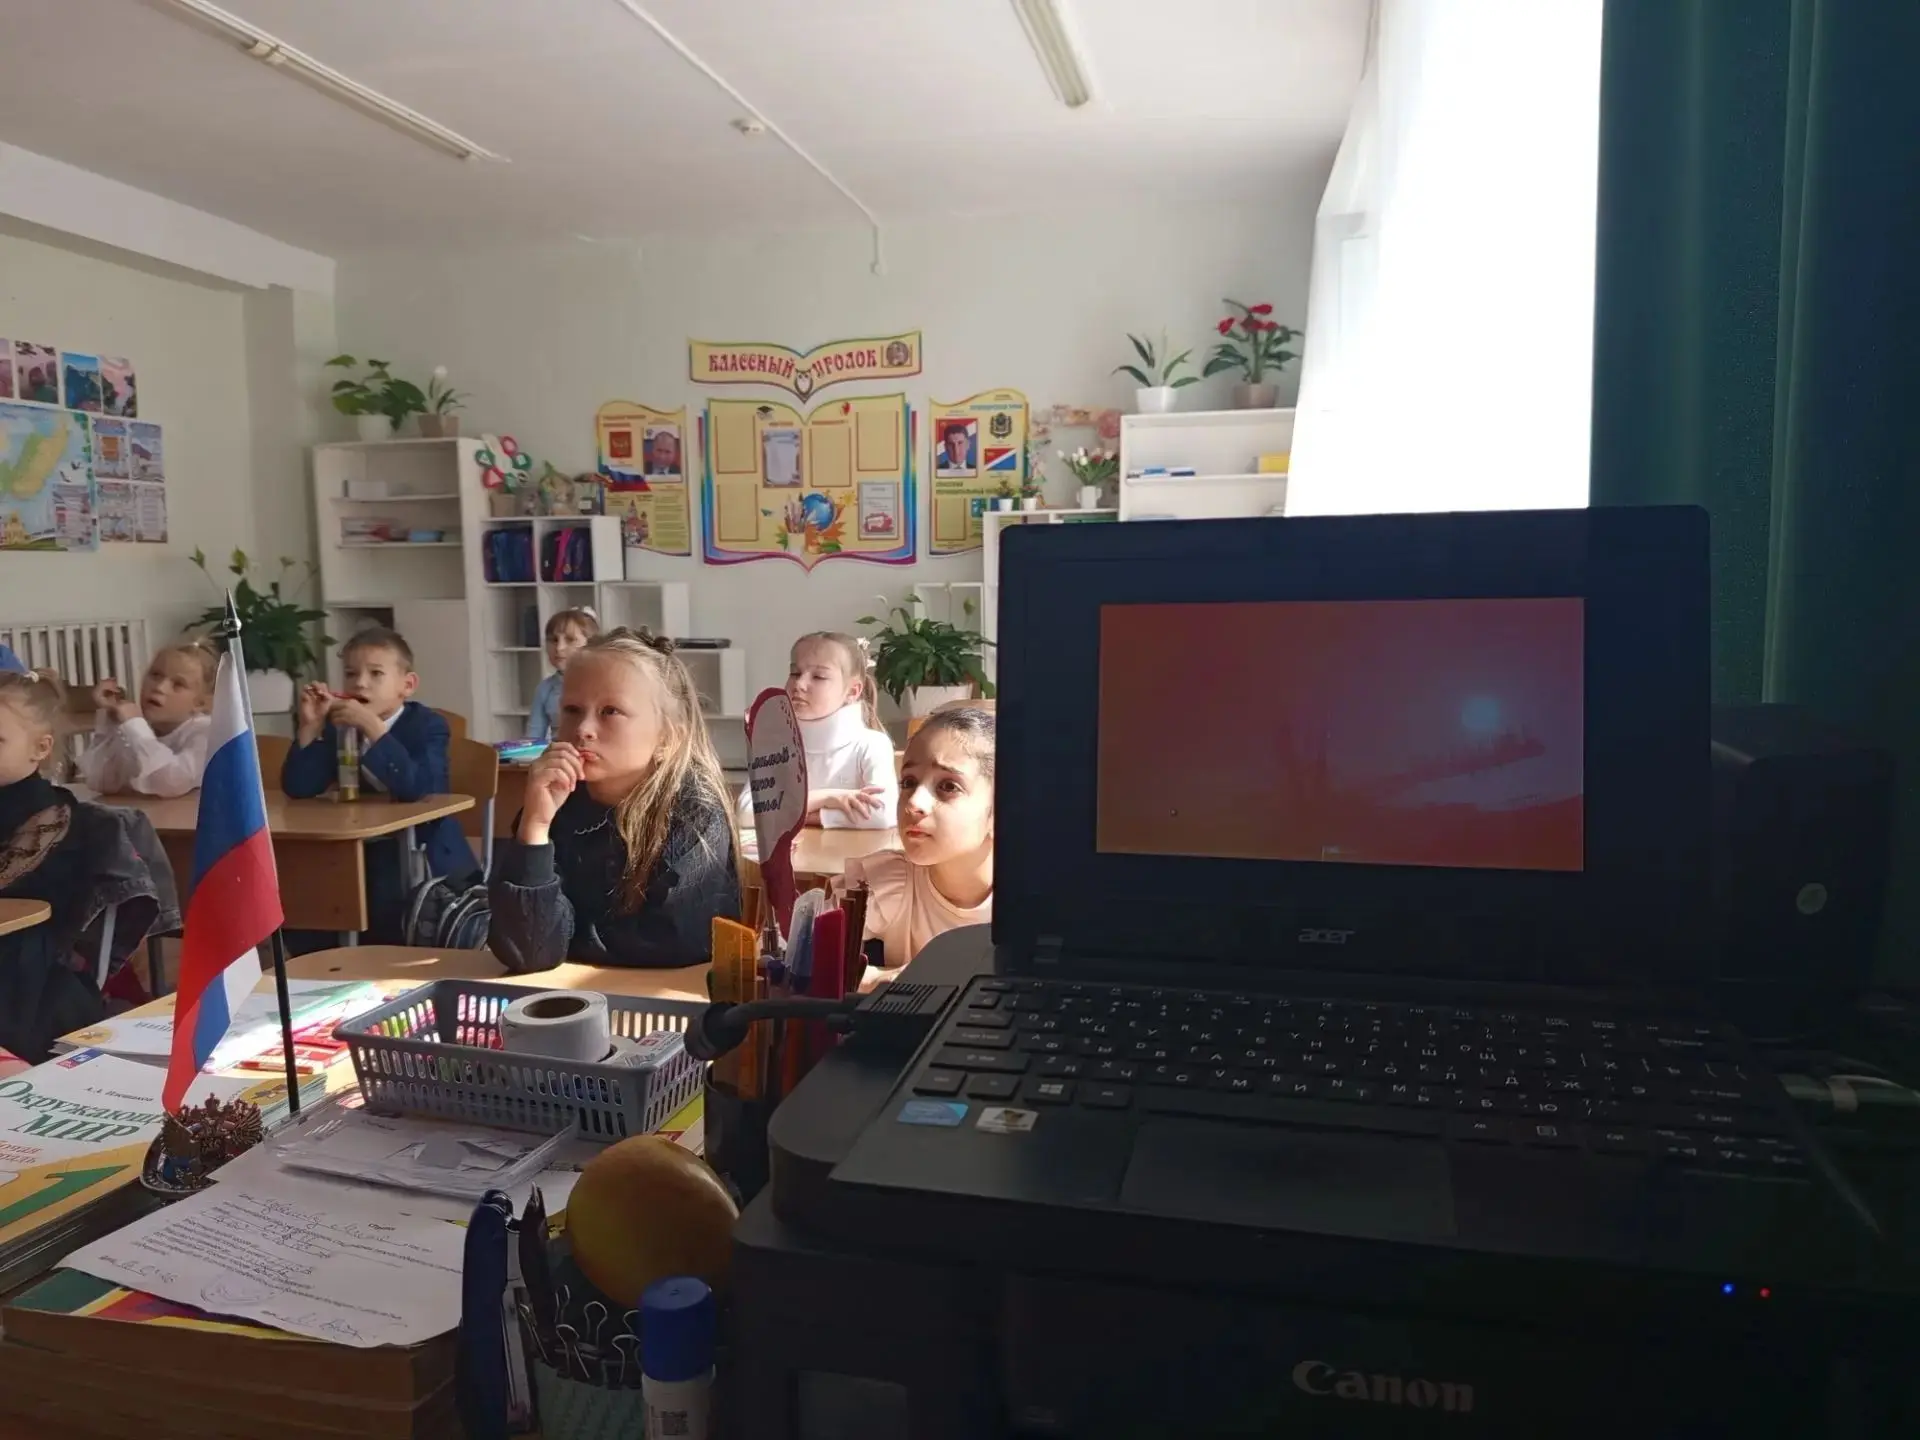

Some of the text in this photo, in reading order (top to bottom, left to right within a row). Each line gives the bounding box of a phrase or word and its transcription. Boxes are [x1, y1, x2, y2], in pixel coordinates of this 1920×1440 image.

[708, 353, 794, 379] КЛАССНЫЙ
[1298, 928, 1356, 944] acer
[8, 1113, 140, 1143] МИР
[1292, 1359, 1474, 1413] Canon
